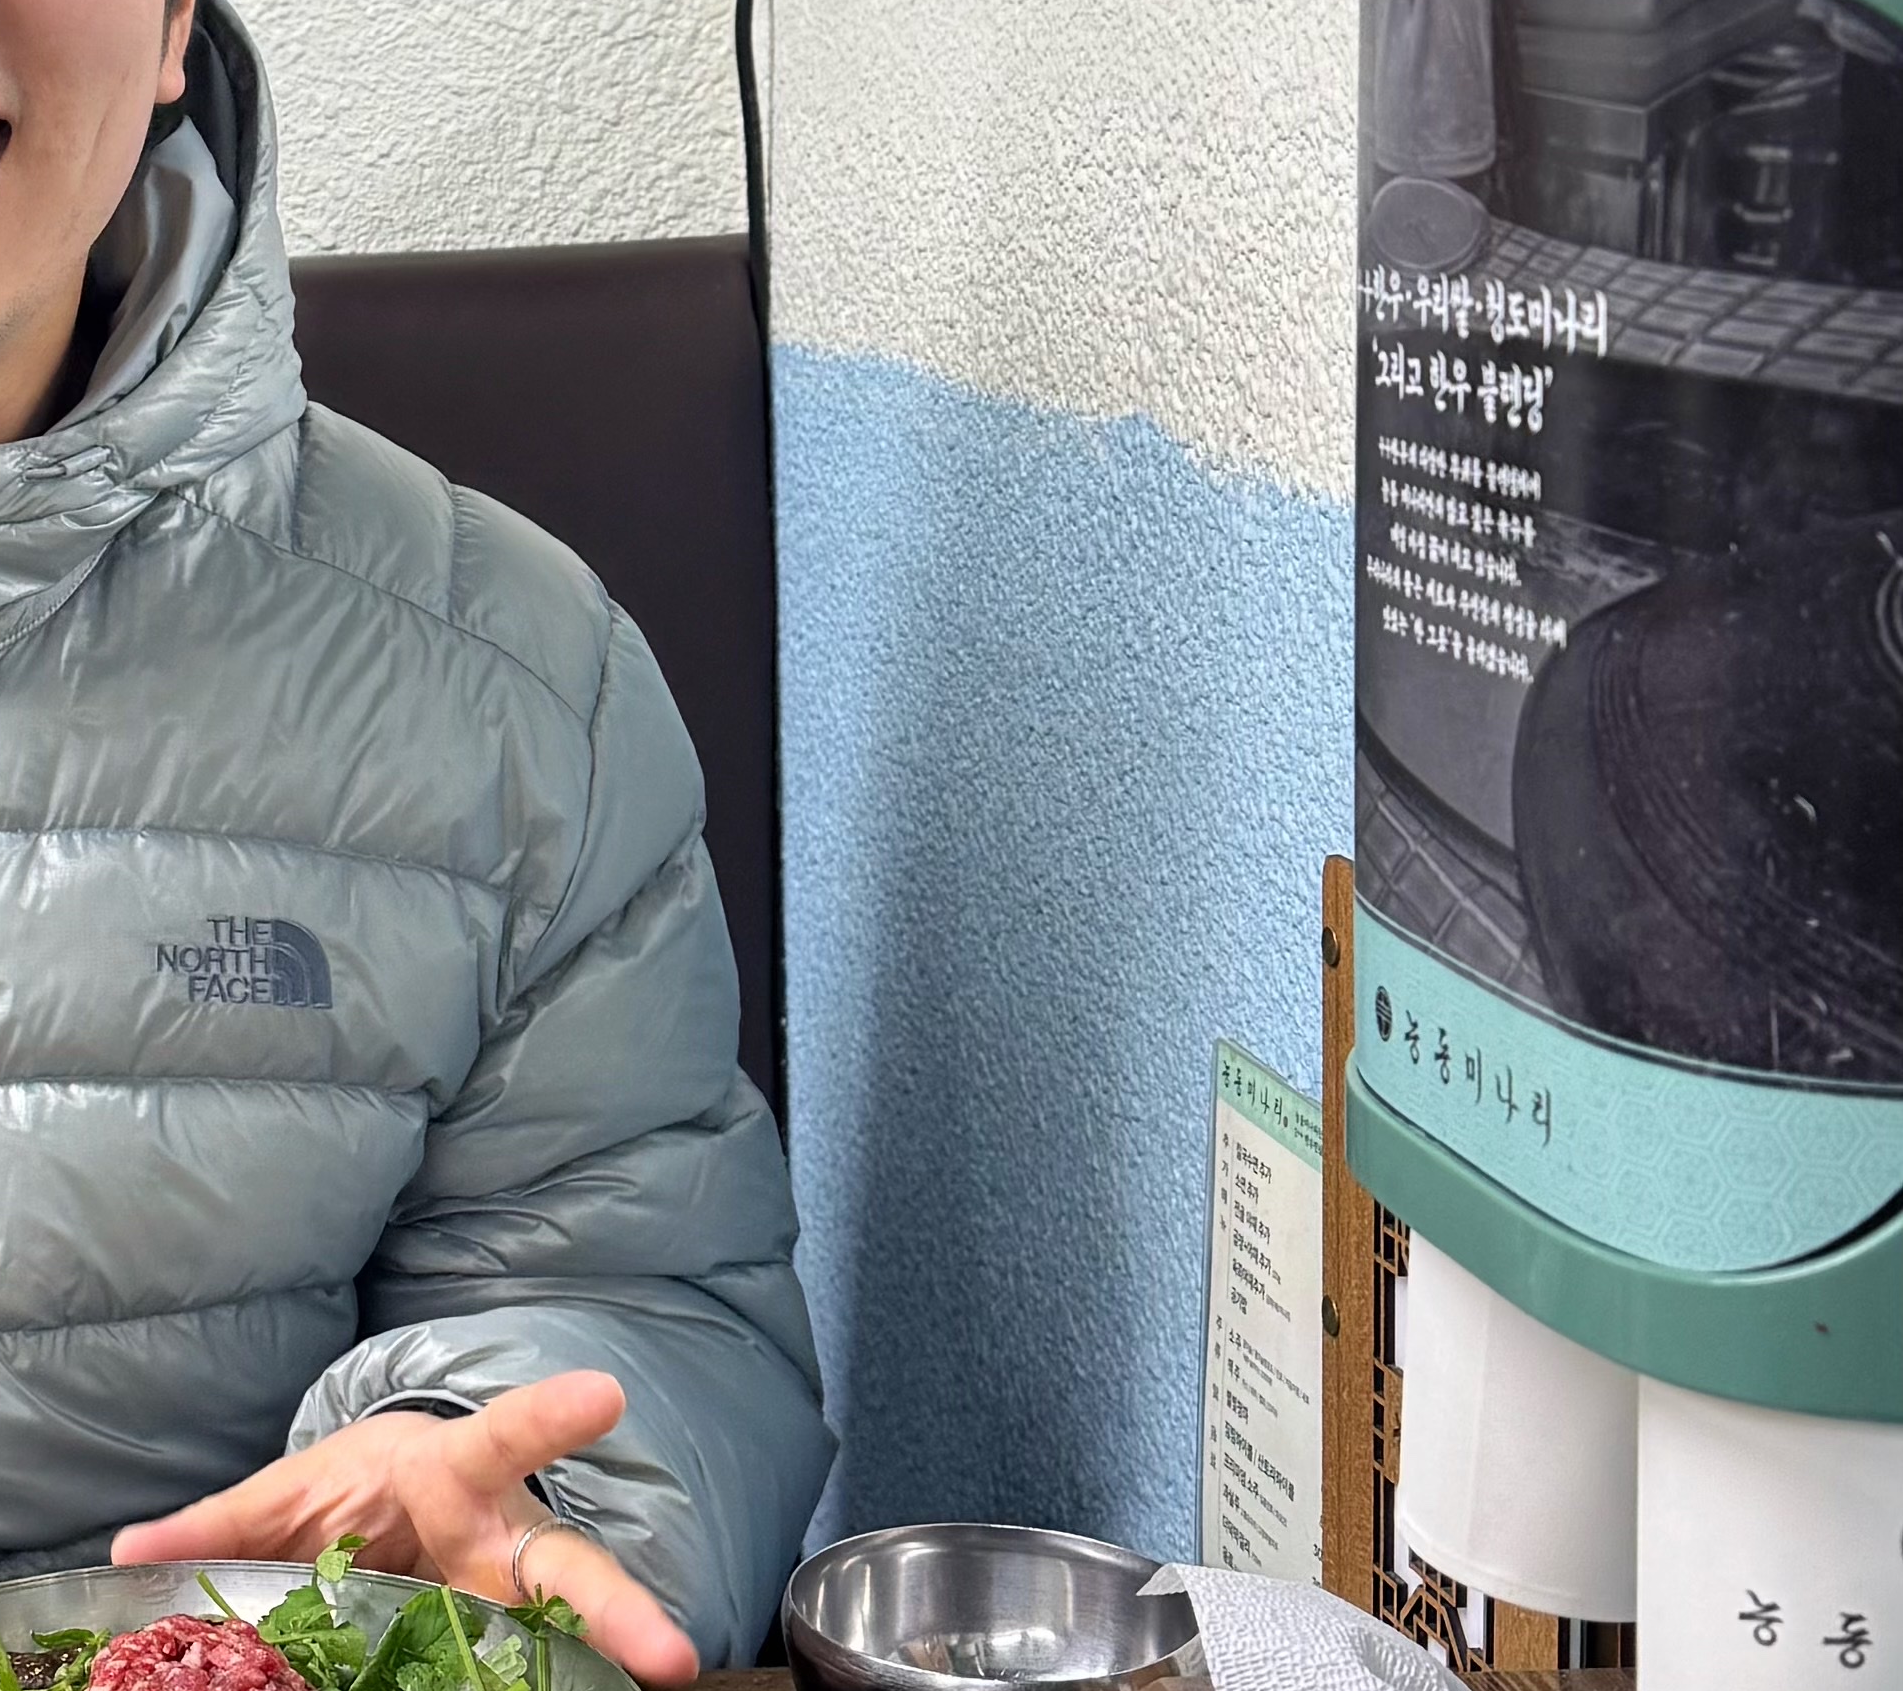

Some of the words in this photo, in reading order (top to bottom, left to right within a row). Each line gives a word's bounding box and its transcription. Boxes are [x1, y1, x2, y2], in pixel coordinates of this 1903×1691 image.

[1428, 348, 1472, 414] 한우
[207, 916, 273, 944] THE
[156, 943, 273, 975] NORTH
[187, 974, 272, 1004] FACE
